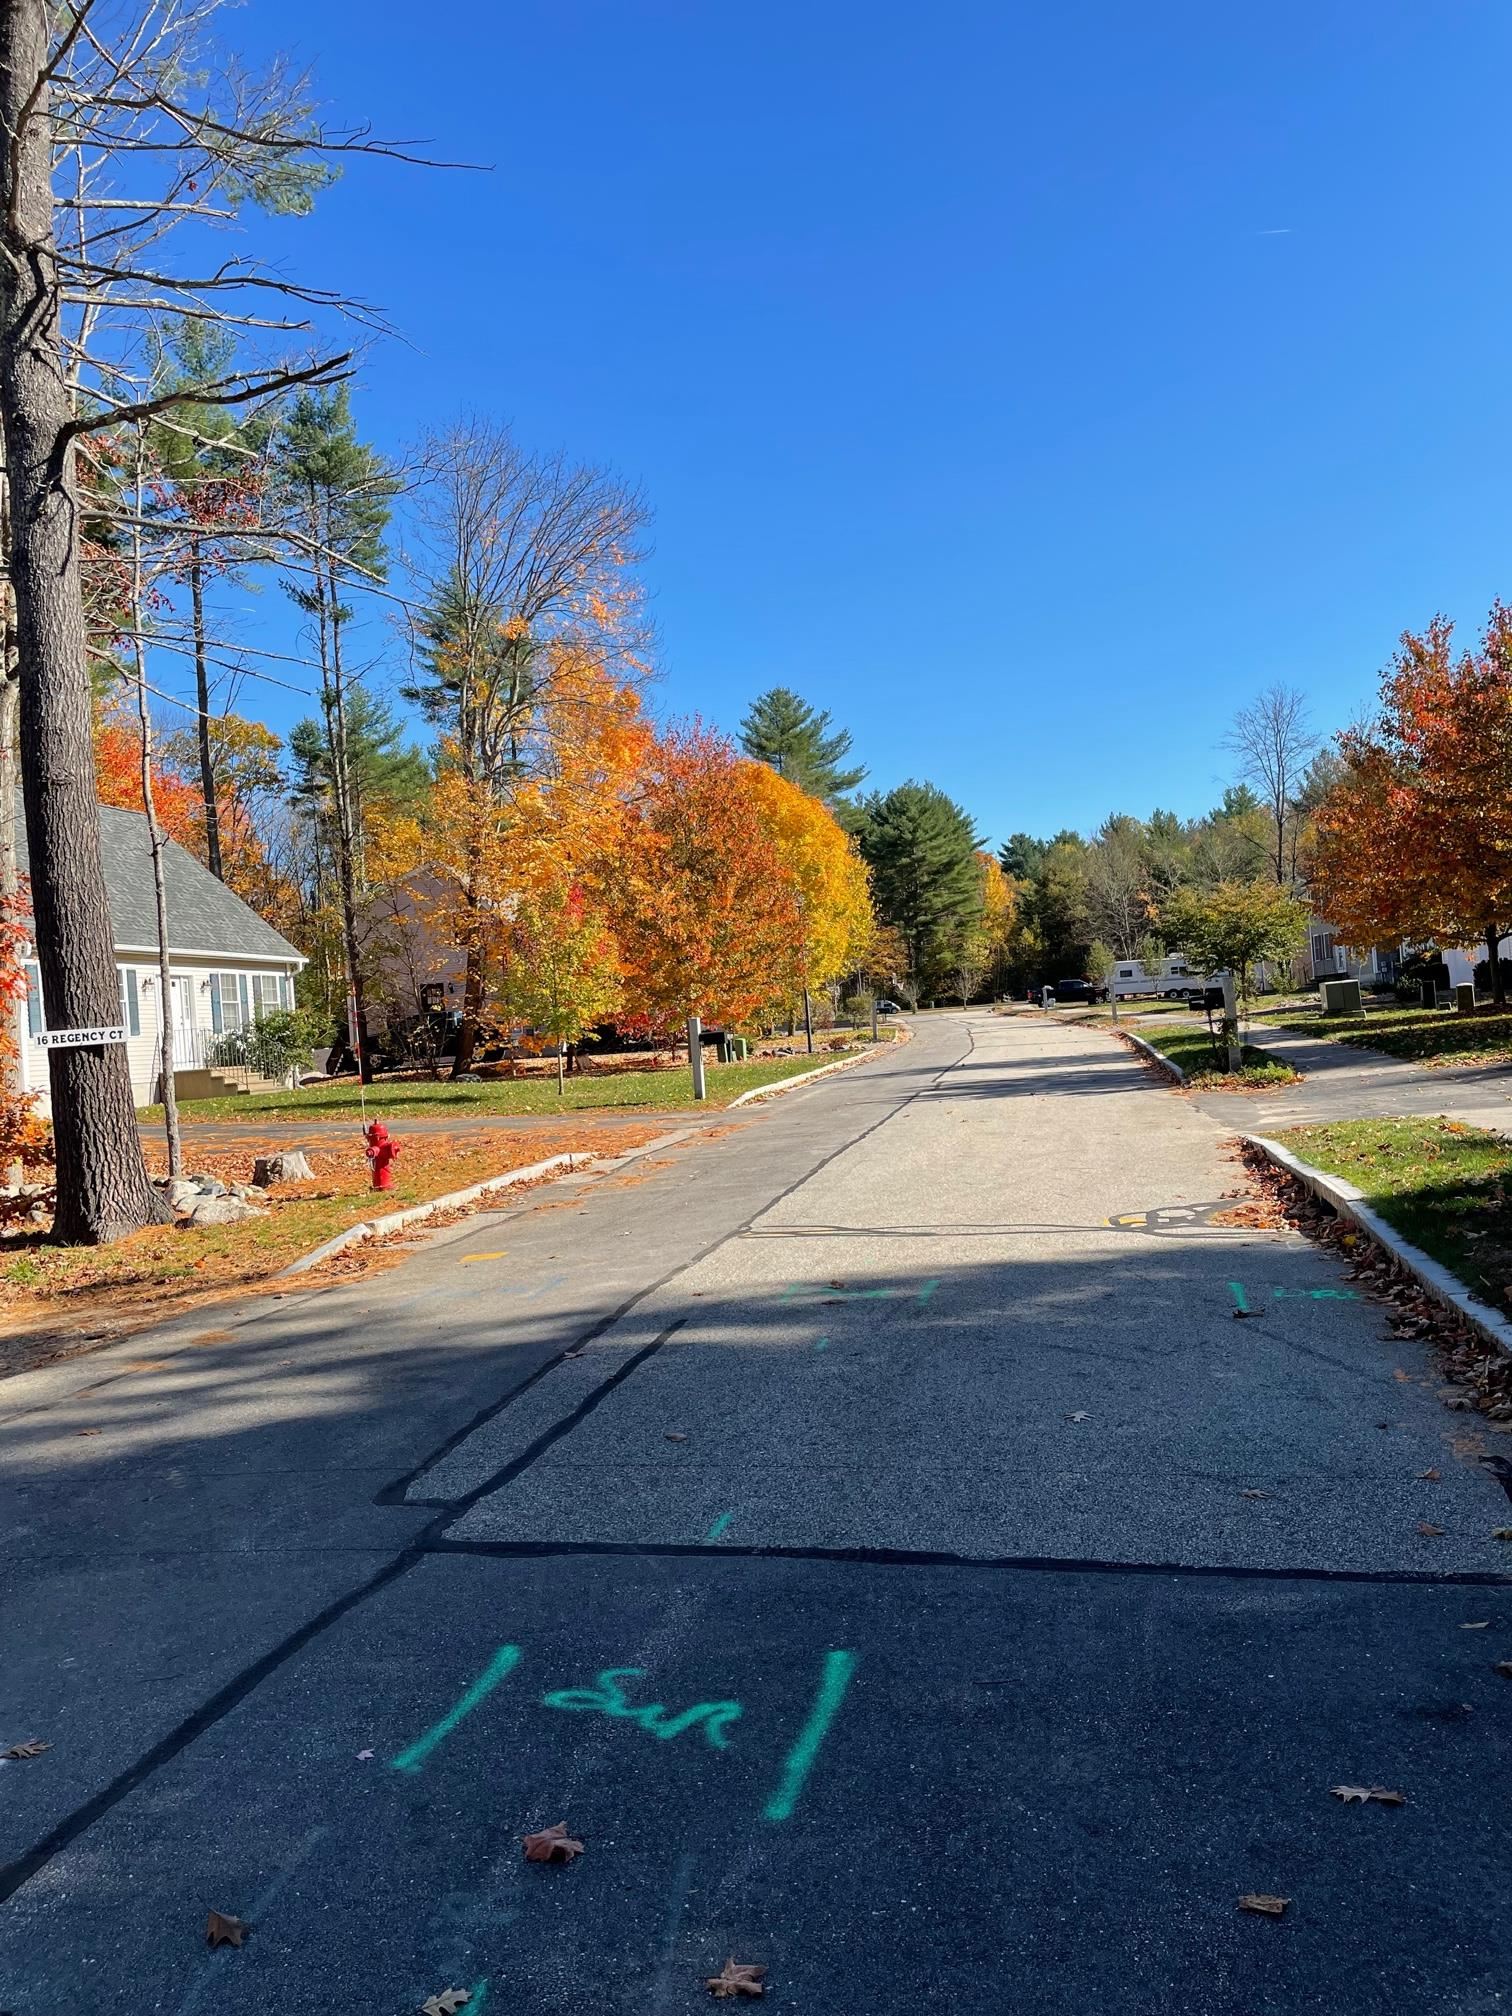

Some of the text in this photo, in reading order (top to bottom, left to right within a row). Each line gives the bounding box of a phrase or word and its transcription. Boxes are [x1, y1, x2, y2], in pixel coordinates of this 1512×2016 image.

[37, 1030, 124, 1045] 16 REGENCY CT
